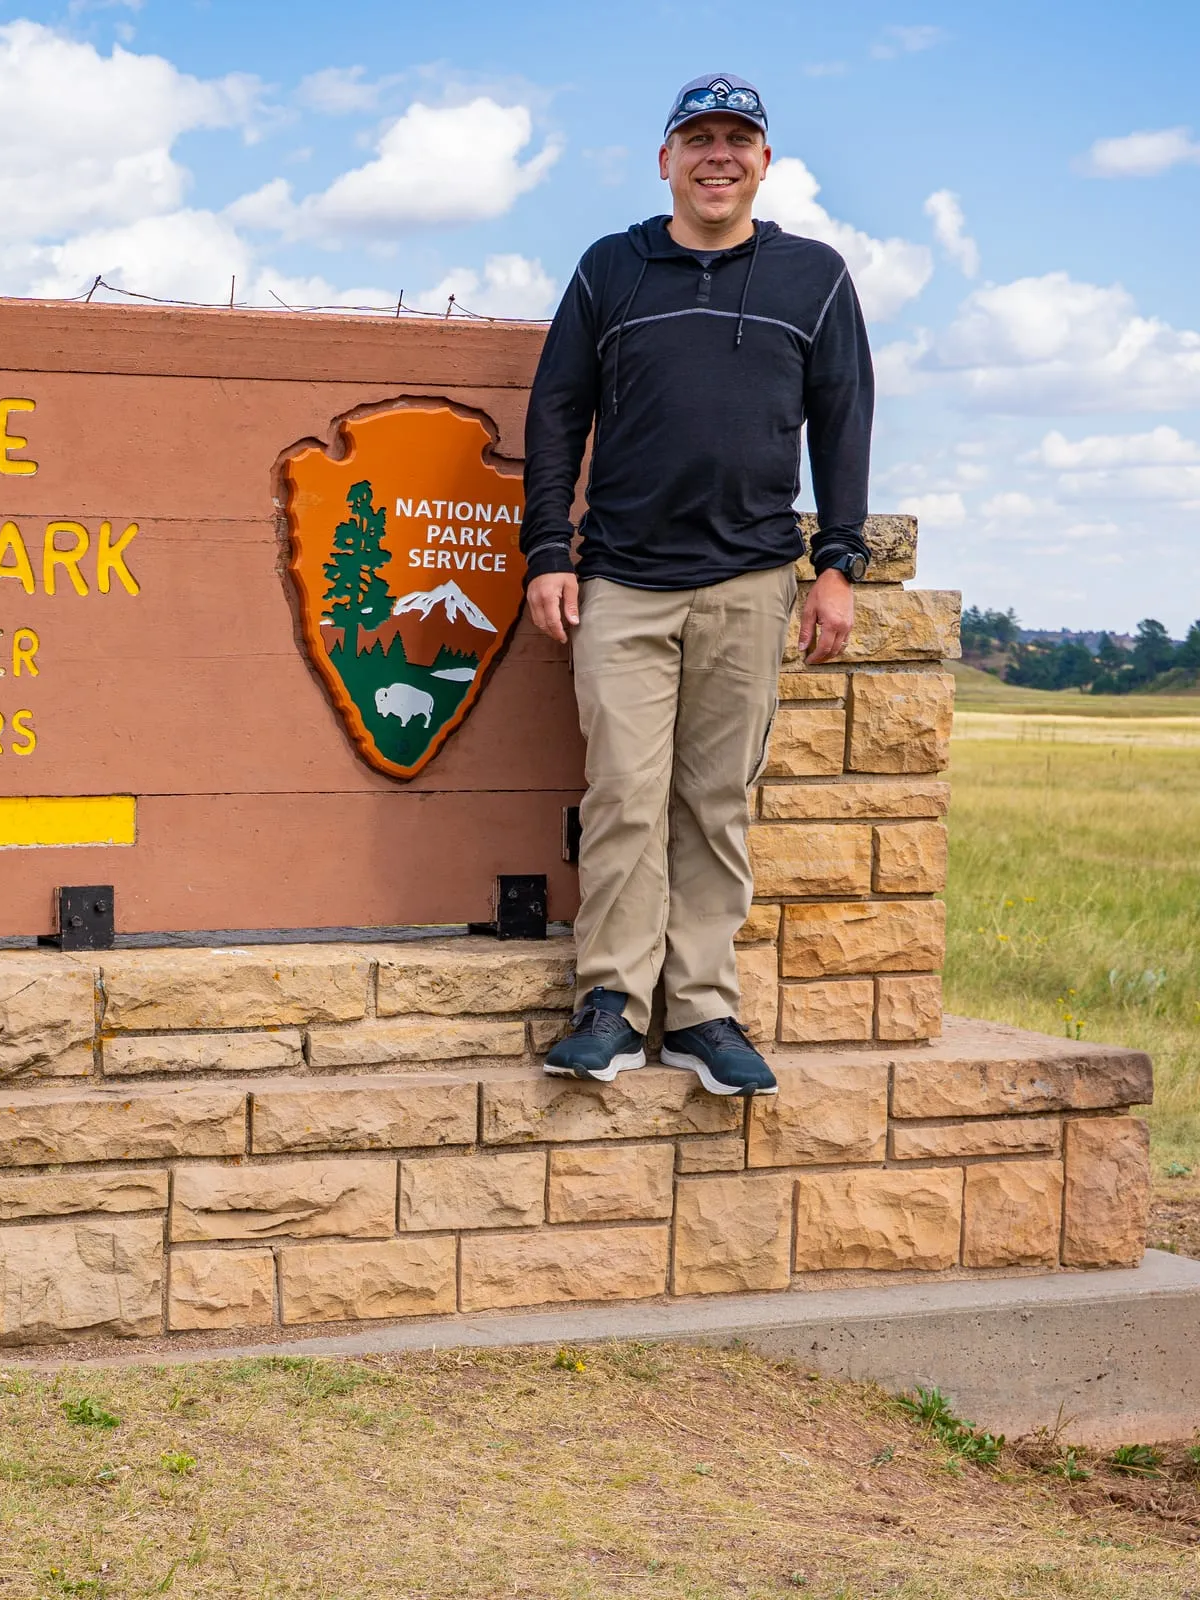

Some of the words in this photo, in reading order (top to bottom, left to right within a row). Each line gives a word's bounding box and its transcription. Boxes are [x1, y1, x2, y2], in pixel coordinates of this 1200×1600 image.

[395, 498, 523, 524] NATIONAL
[427, 525, 492, 547] PARK
[408, 549, 506, 573] SERVICE
